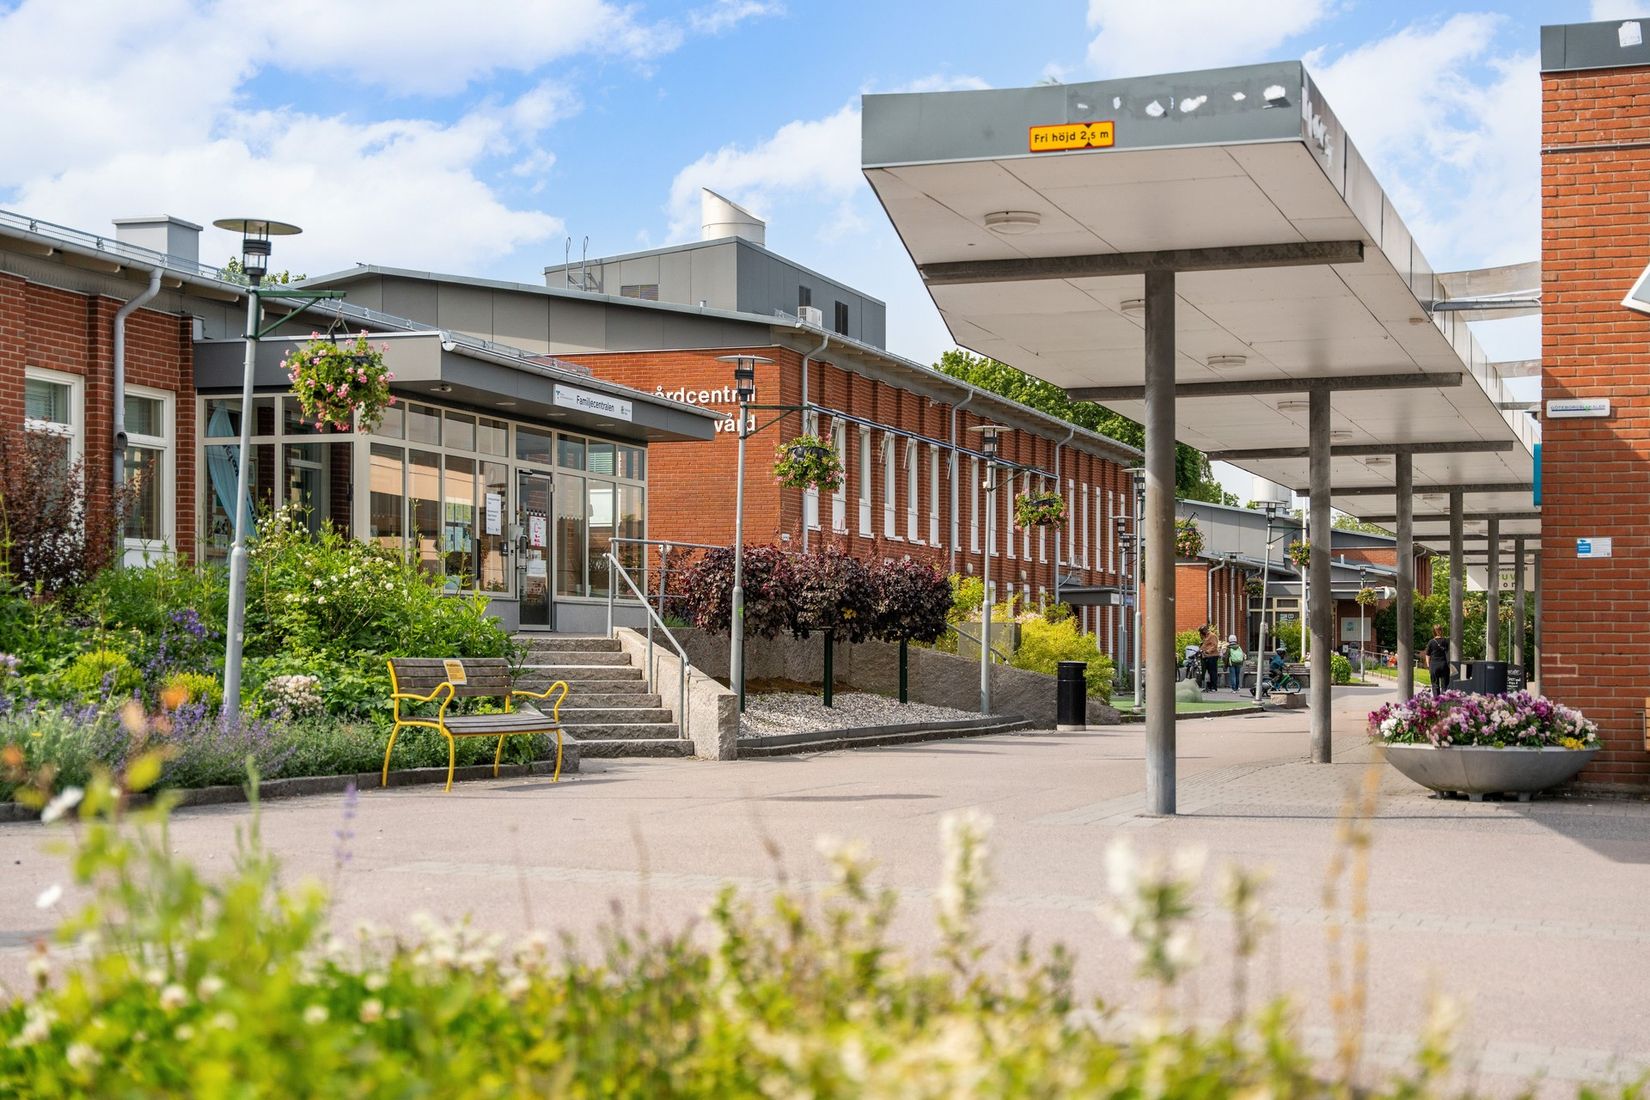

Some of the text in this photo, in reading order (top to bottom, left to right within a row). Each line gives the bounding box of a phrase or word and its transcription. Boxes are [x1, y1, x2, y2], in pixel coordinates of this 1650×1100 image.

[1034, 130, 1109, 143] Fri höjd 2,5 m
[576, 394, 615, 412] Familjecentralen
